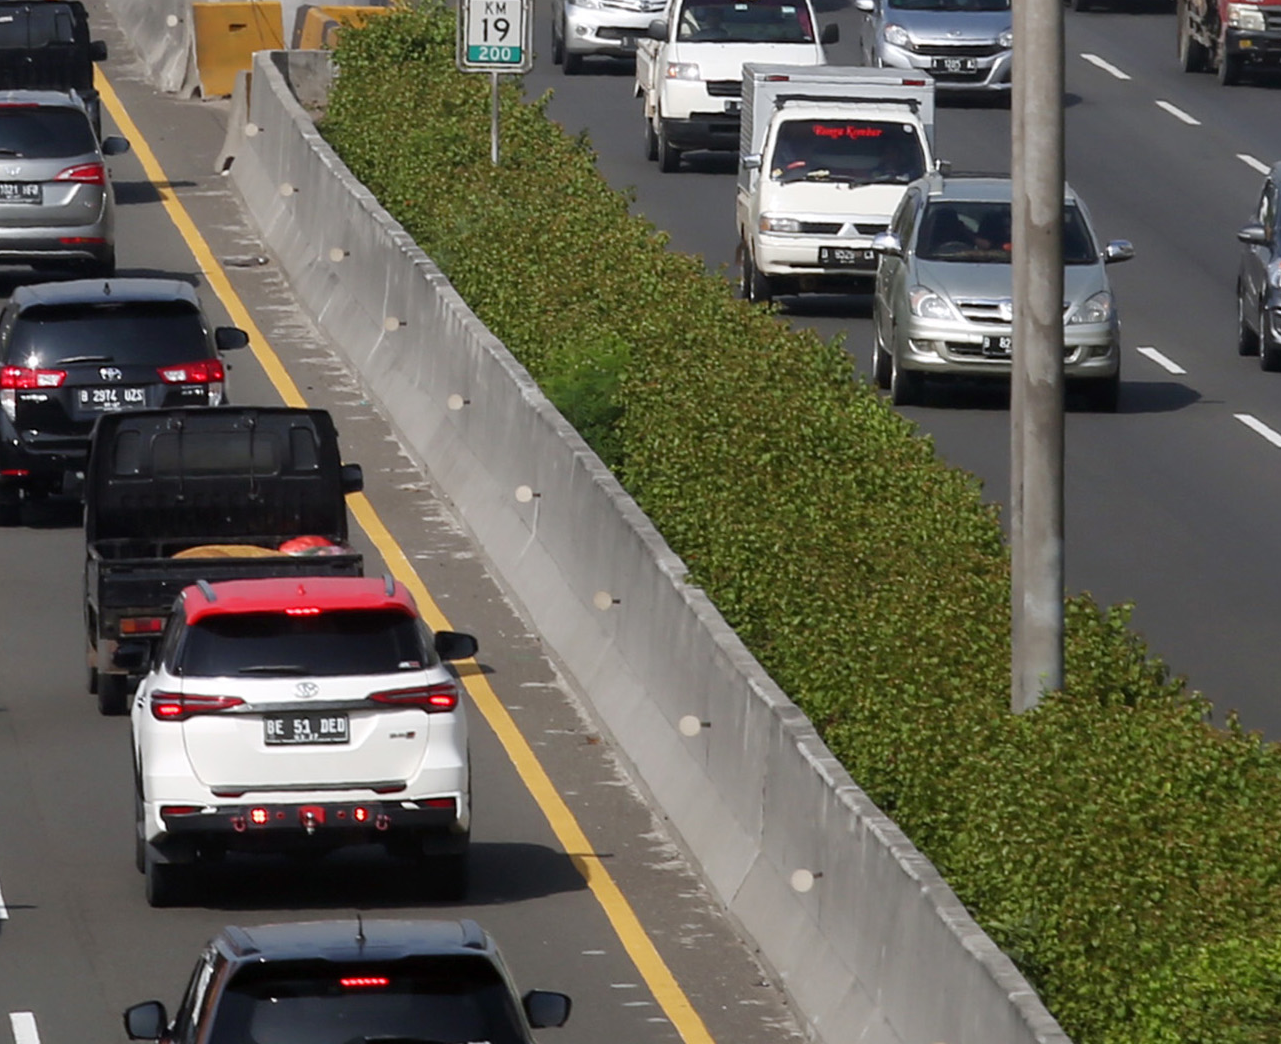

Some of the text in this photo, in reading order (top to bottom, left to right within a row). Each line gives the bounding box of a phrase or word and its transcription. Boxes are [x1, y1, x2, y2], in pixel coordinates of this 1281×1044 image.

[485, 2, 506, 15] KM
[483, 18, 510, 42] 19
[479, 47, 511, 60] 200
[81, 390, 89, 402] B
[267, 718, 346, 735] BE 51 DED
